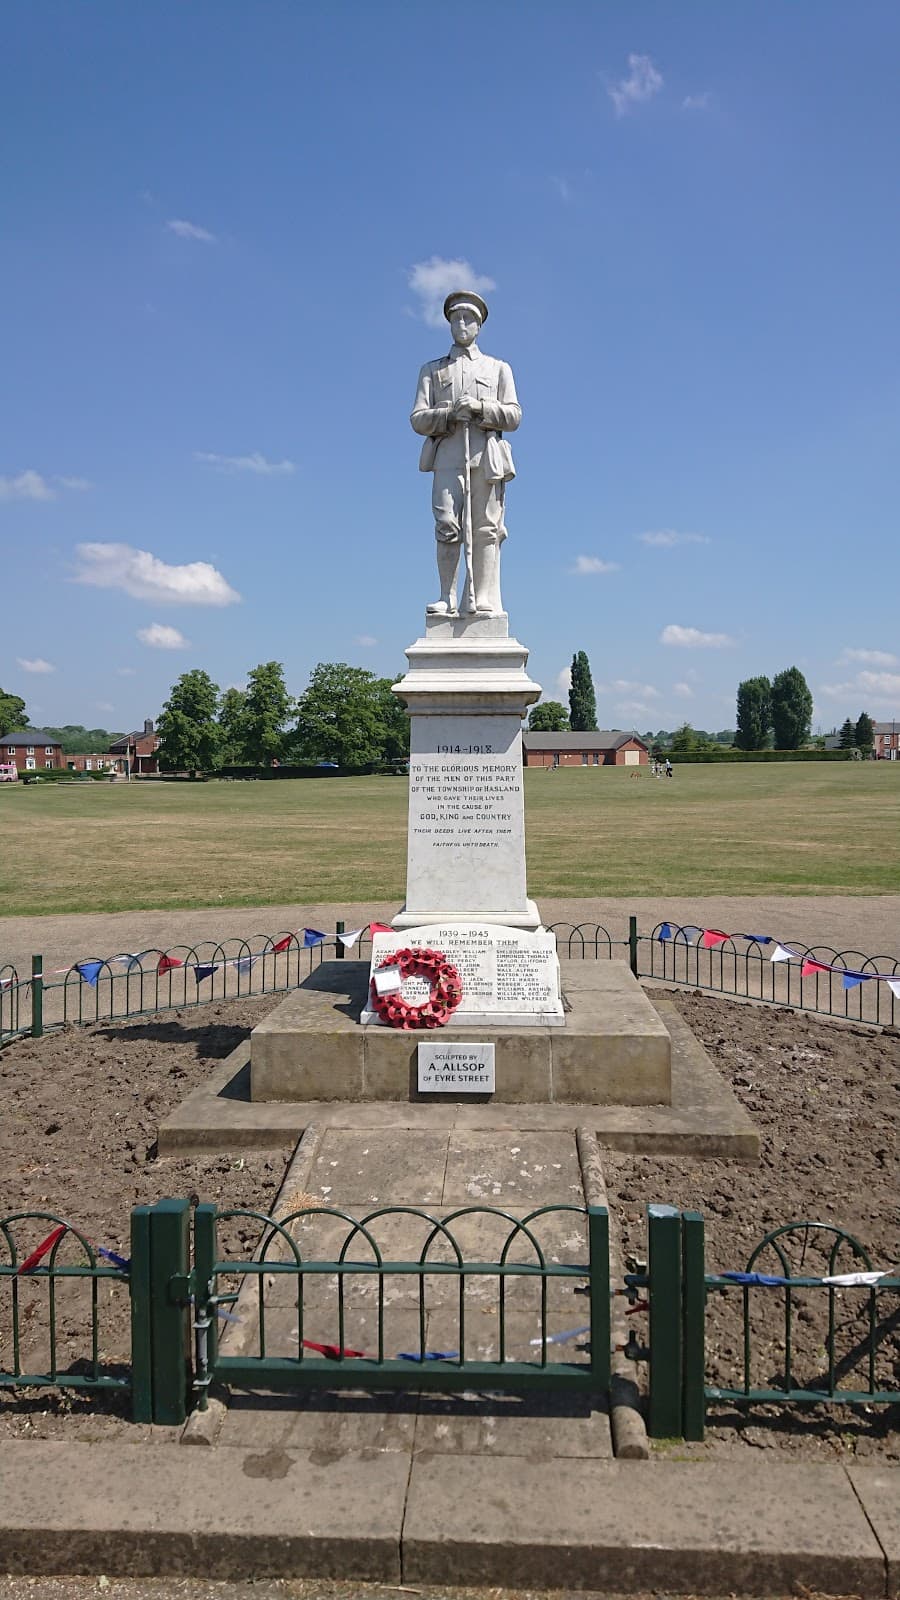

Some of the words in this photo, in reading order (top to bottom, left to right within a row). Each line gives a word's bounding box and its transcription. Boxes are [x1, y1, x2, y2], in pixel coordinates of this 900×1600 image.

[412, 765, 421, 773] TO
[425, 765, 439, 773] THE
[441, 765, 479, 773] GLORIOUS
[482, 765, 517, 773] MEMORY
[428, 1063, 439, 1071] A.
[443, 1063, 485, 1071] ALLSOP
